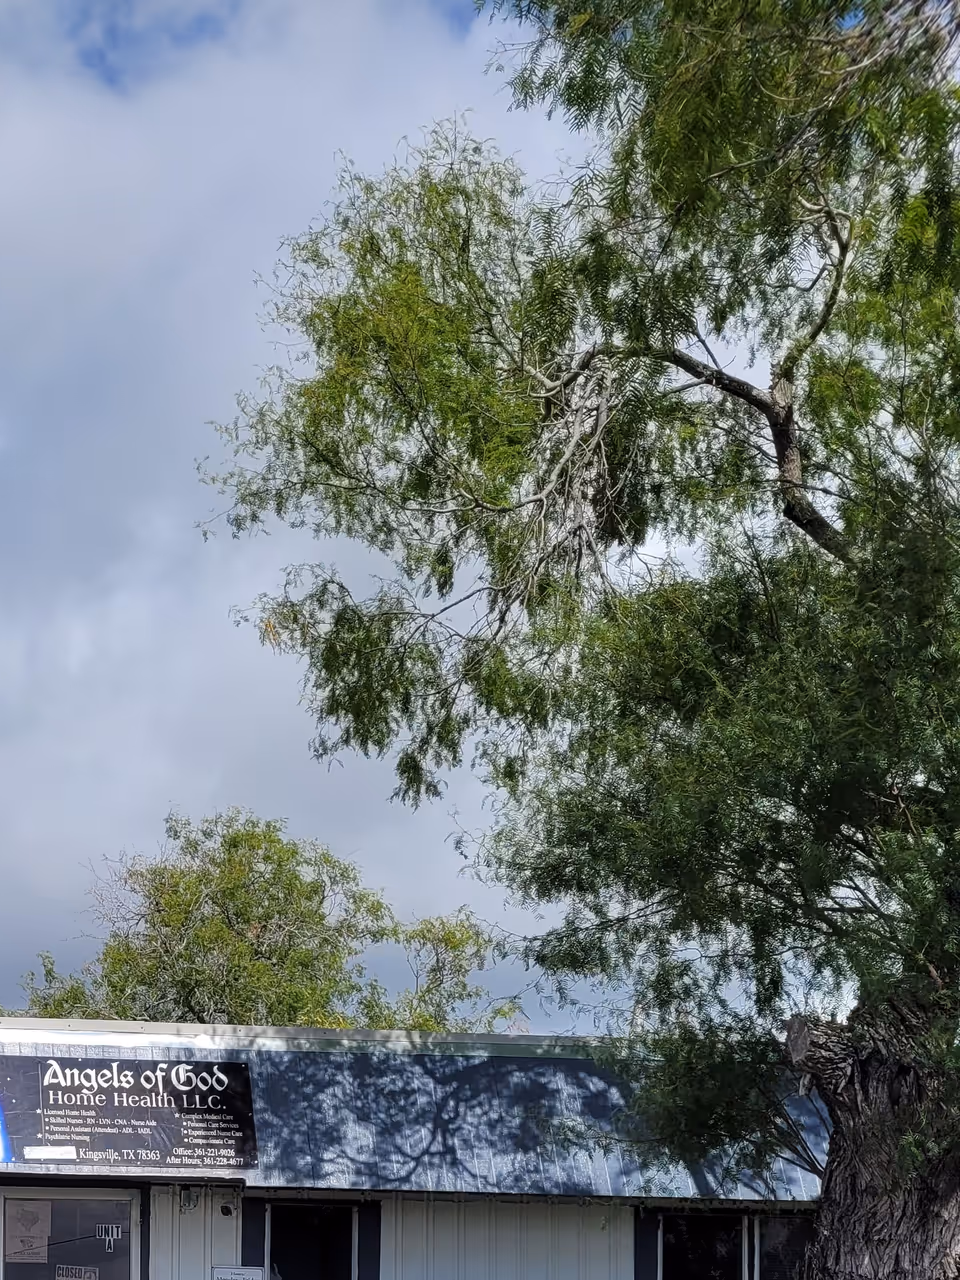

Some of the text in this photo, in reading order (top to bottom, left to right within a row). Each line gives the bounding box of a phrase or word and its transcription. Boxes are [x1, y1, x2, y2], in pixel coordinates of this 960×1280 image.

[43, 1060, 229, 1095] Angels of God
[48, 1090, 227, 1109] Home Health LLC.
[45, 1133, 90, 1142] Psychiatric Nursing
[79, 1148, 161, 1162] Kingsville, TX 78363
[172, 1148, 236, 1157] Office: 361-221-9026
[166, 1156, 182, 1164] After
[203, 1157, 244, 1166] 361-228-4677
[98, 1225, 120, 1238] UNIT
[106, 1239, 112, 1251] A
[57, 1265, 82, 1279] CLOSED
